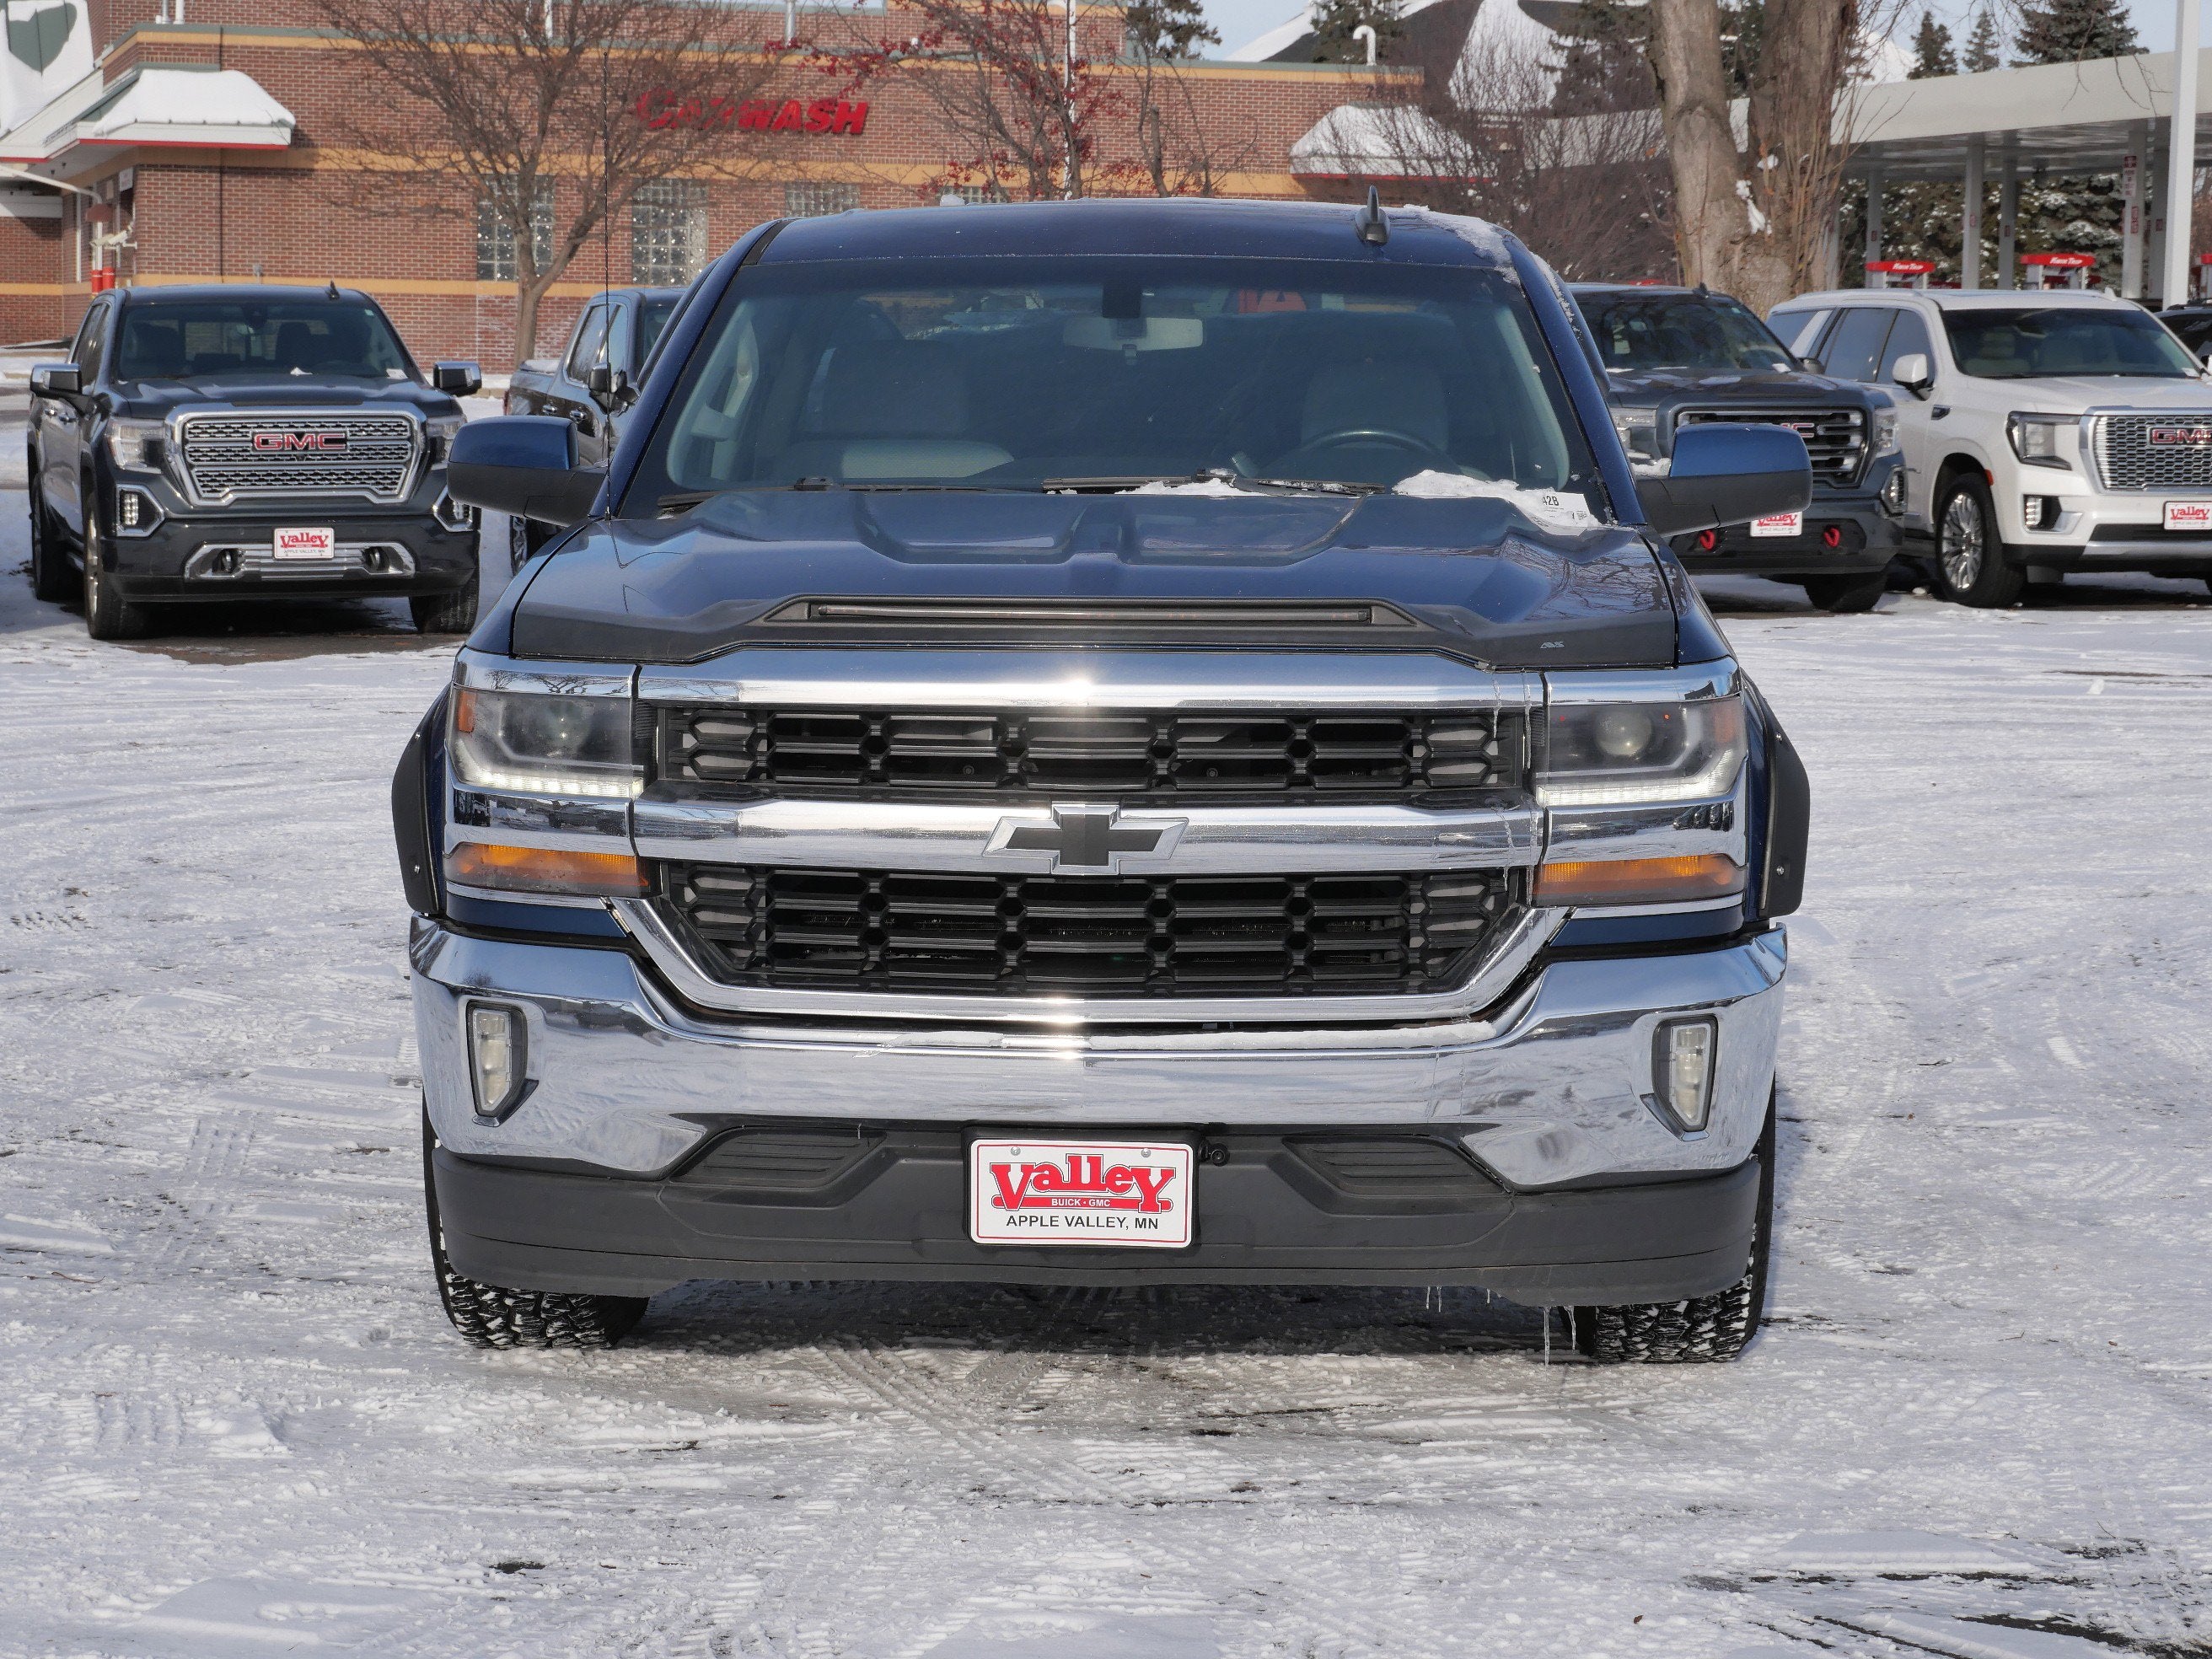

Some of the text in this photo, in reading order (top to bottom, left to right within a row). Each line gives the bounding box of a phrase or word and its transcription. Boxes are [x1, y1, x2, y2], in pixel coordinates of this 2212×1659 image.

[738, 99, 868, 133] WASH
[255, 433, 346, 450] GMC
[1051, 1198, 1110, 1207] BUICK GMC
[1006, 1215, 1158, 1230] APPLE VALLEY, MN
